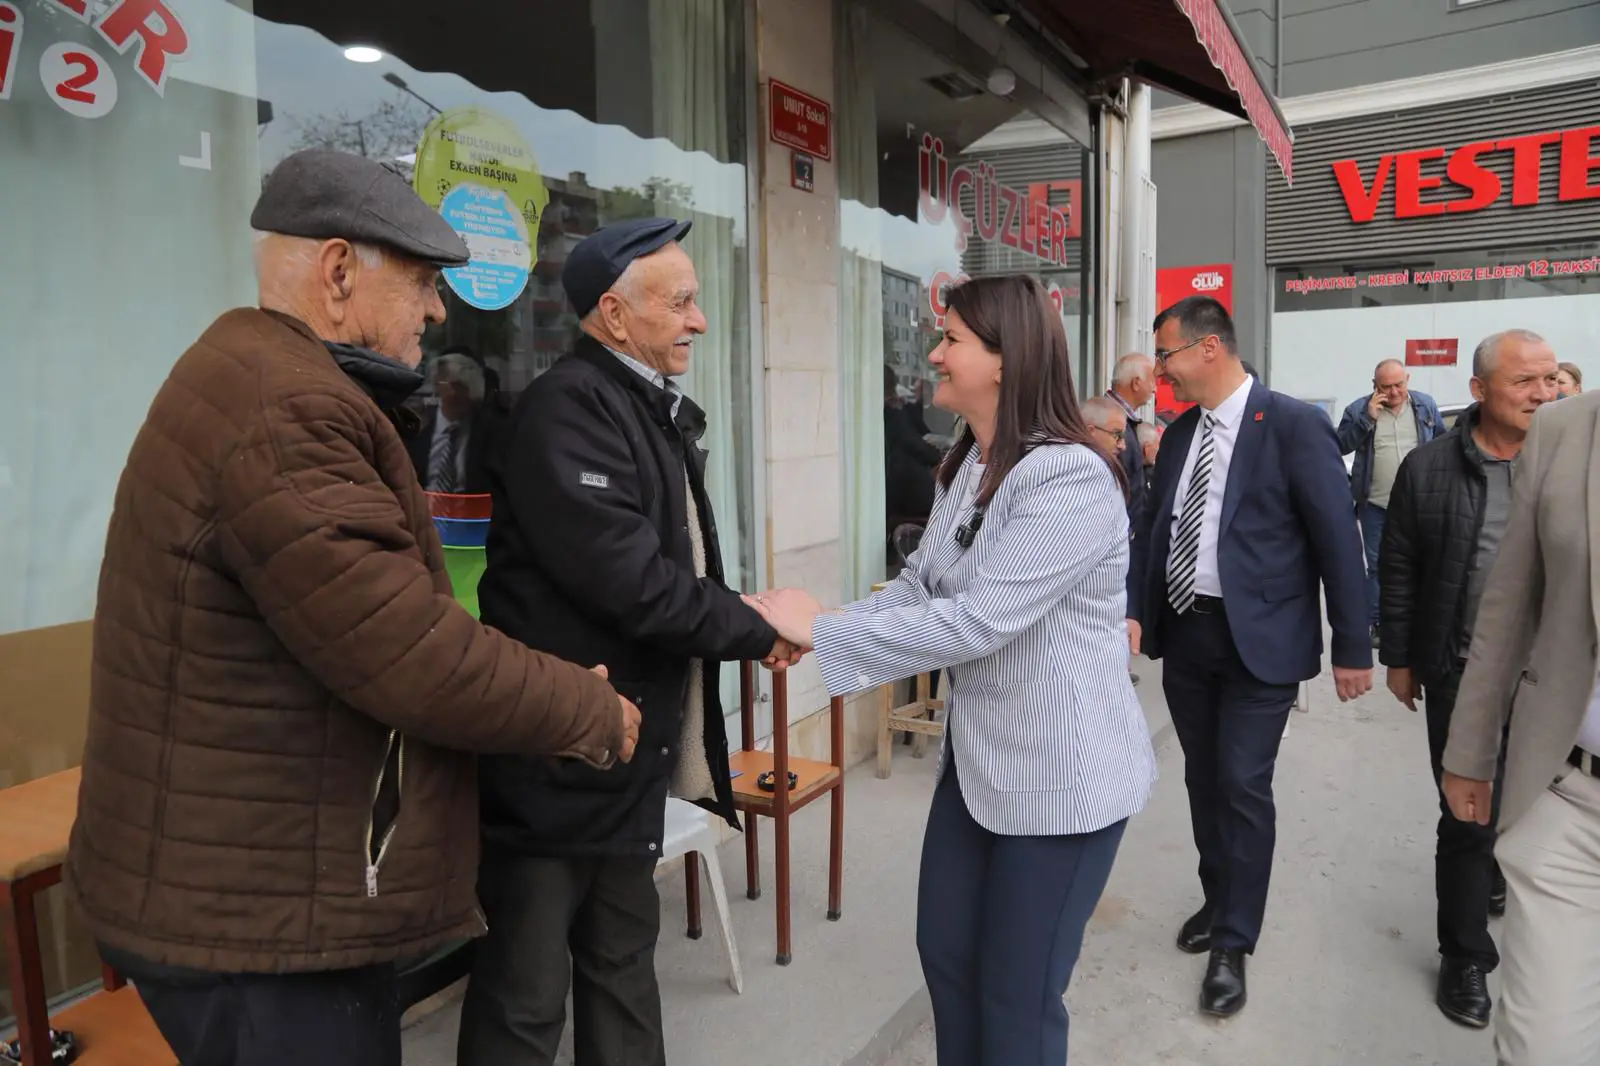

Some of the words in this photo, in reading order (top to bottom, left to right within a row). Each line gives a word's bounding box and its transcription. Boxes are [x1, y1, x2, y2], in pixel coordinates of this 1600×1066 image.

[56, 52, 99, 104] 2
[783, 95, 805, 117] UMUT
[440, 129, 524, 157] FUTBOLSEVERLER
[449, 159, 481, 176] EXXEN
[483, 167, 518, 183] BAŞINA
[1332, 126, 1600, 223] VESTE
[919, 132, 1067, 268] ÜÇÜZLER
[1191, 275, 1224, 289] OLUR
[1285, 276, 1357, 295] PEŞİNATSIZ
[1368, 269, 1409, 287] KREDİ
[1414, 267, 1473, 285] KARTSIZ
[1475, 264, 1525, 281] ELDEN
[1528, 259, 1549, 277] 12
